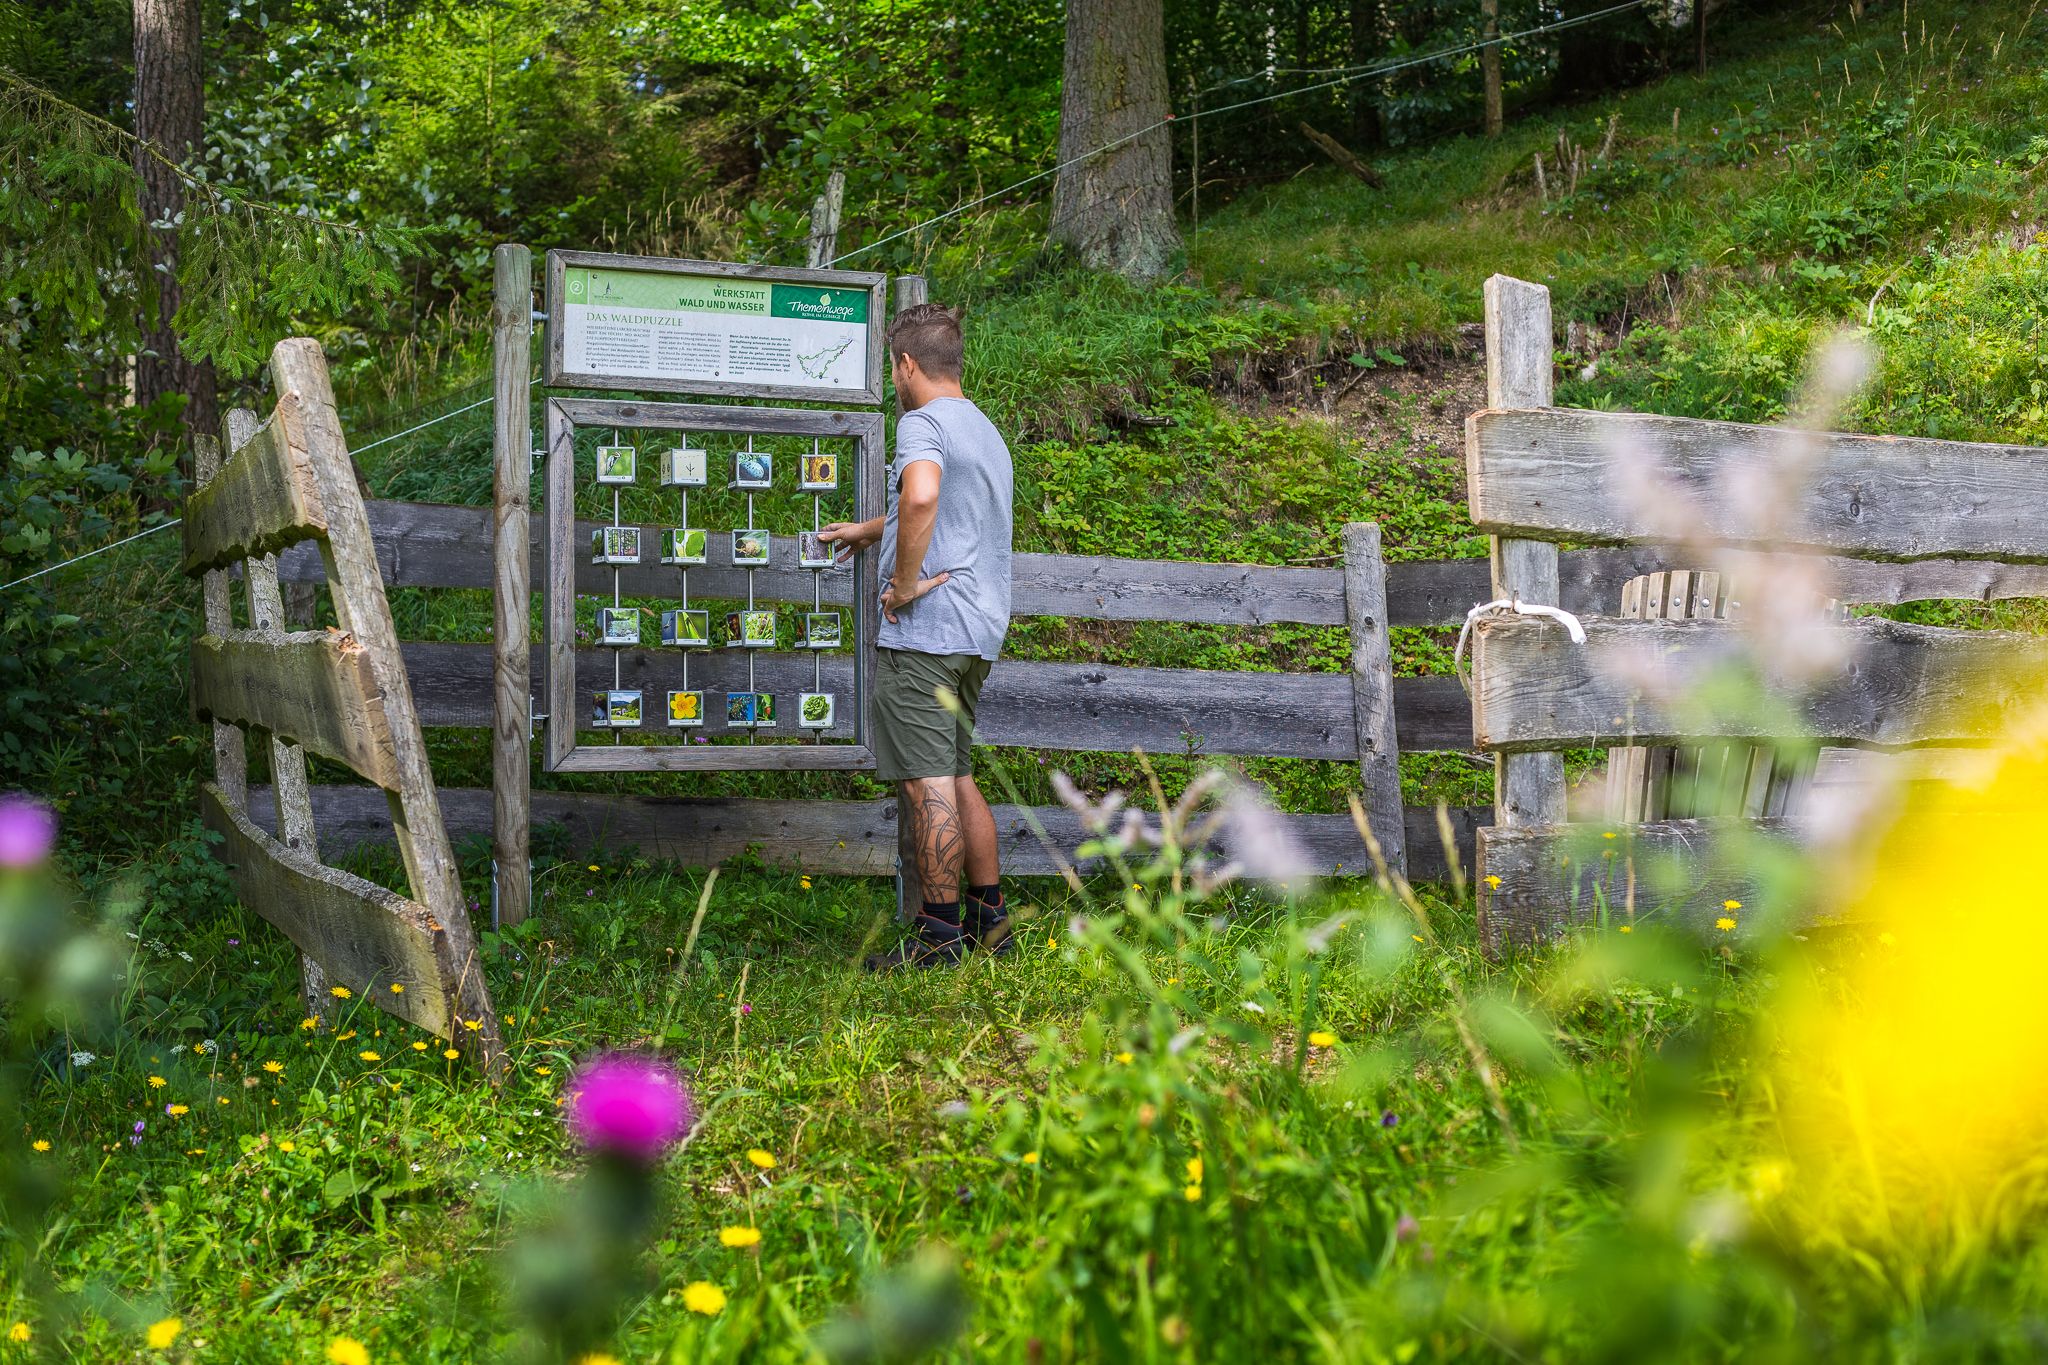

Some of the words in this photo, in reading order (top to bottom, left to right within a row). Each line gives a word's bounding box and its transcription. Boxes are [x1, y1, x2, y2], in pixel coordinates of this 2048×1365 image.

[714, 289, 765, 299] WERKSTATT
[679, 298, 704, 307] WALD
[707, 301, 725, 309] UND
[728, 302, 764, 311] WASSER
[787, 301, 853, 320] Themenwege
[587, 313, 607, 322] DAS
[611, 314, 683, 327] WALDPUZZLE
